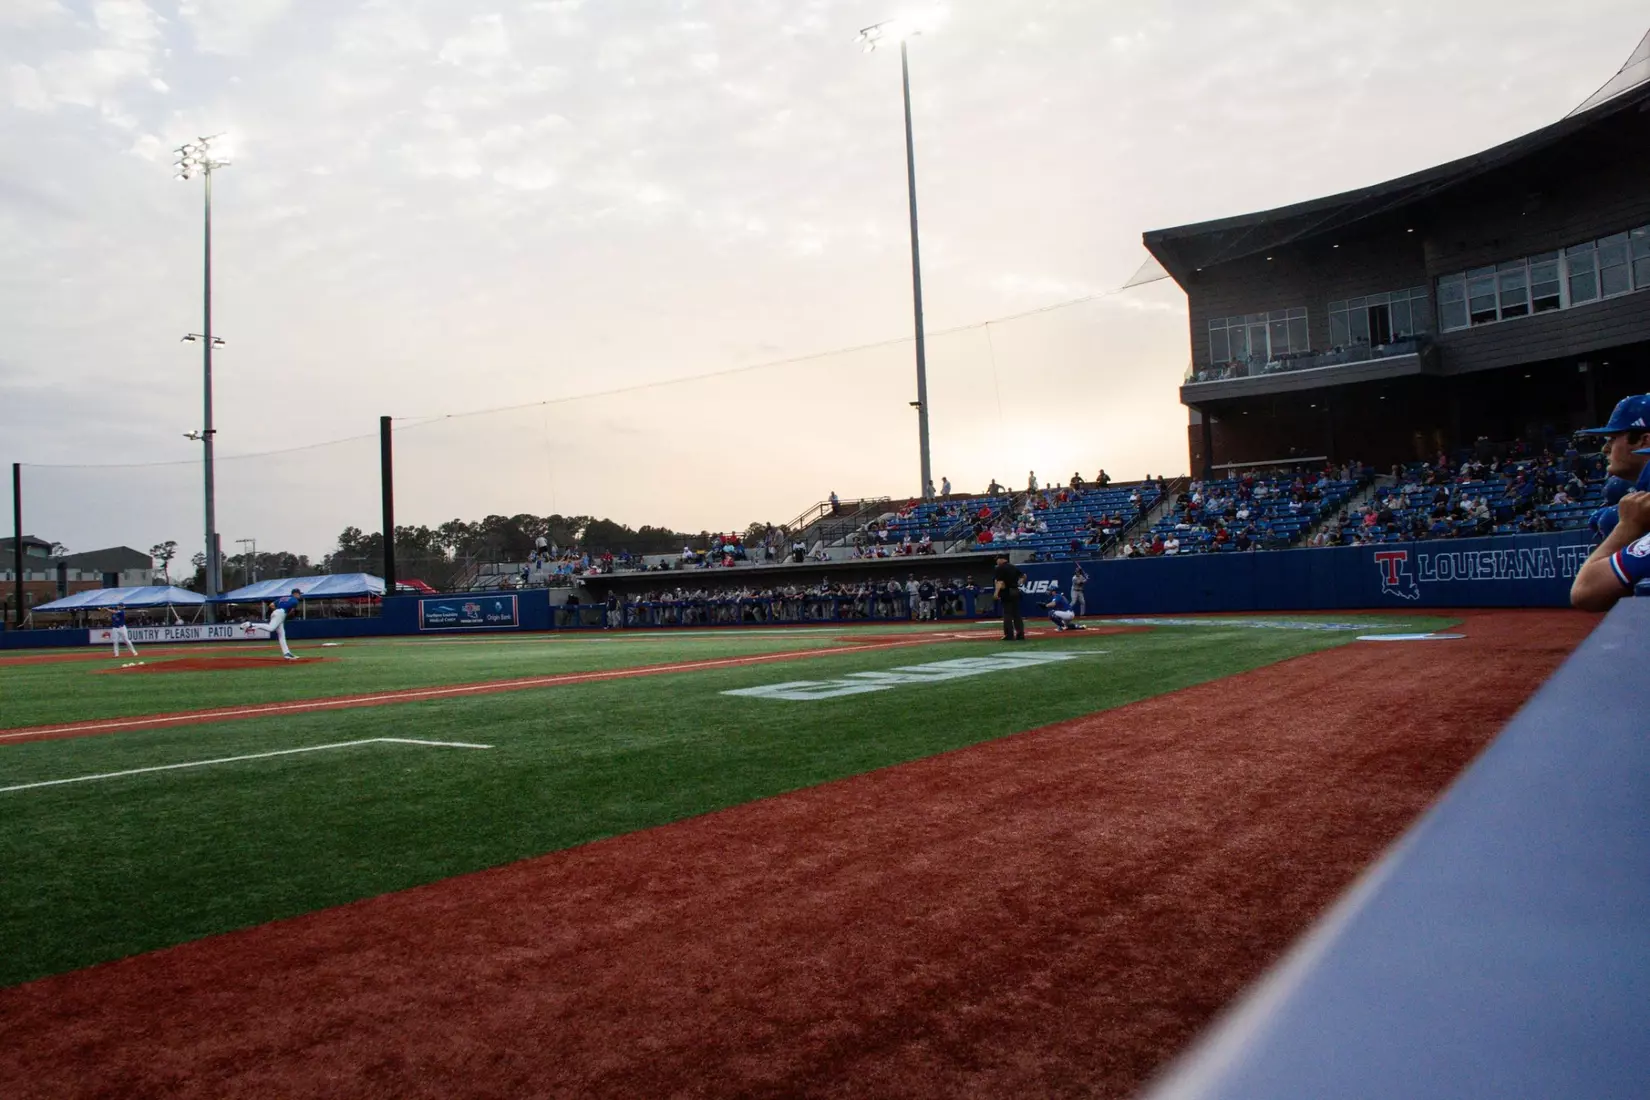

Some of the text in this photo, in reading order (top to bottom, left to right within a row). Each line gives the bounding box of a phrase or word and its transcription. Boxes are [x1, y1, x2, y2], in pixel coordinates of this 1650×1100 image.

[1417, 544, 1599, 582] LOUISIANA TE
[486, 614, 500, 622] Origin
[127, 629, 160, 641] OUNTRY
[208, 626, 233, 638] PATIO
